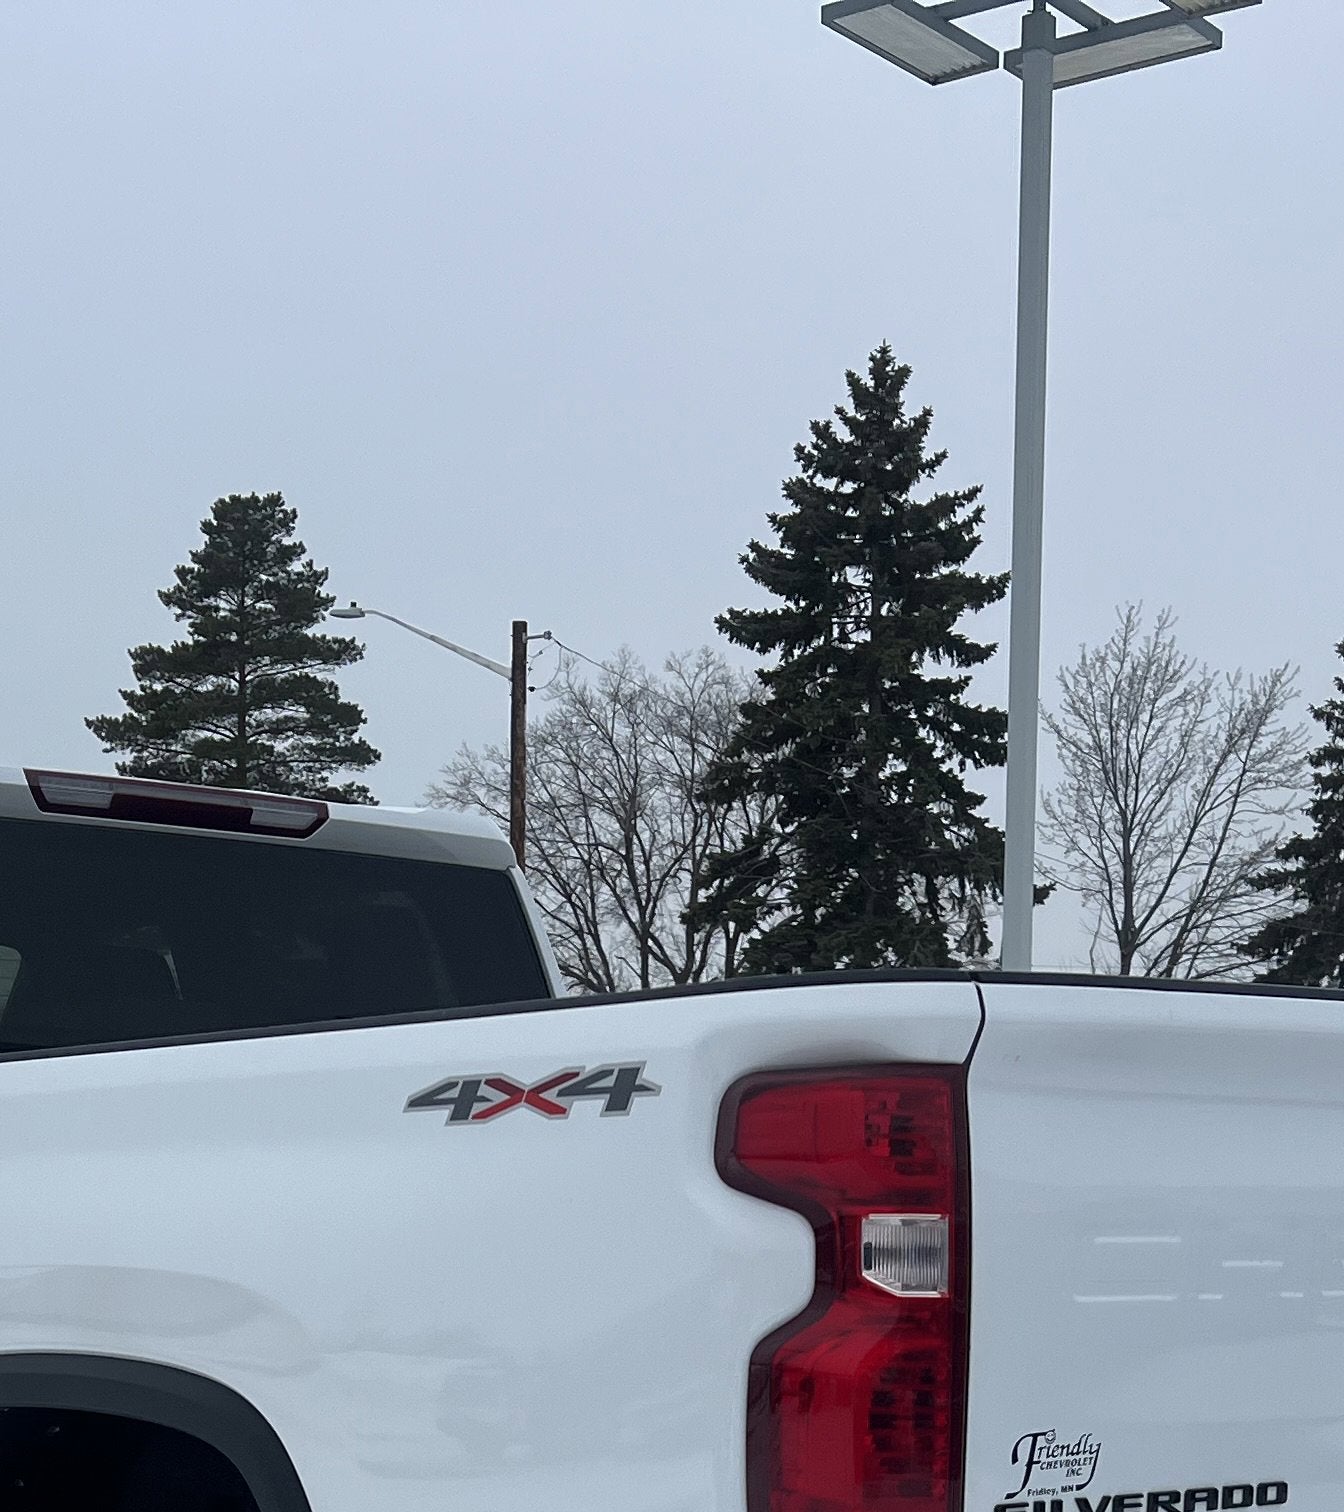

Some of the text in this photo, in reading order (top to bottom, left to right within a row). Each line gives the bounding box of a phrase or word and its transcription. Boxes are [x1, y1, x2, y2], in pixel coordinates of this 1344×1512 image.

[1004, 1428, 1102, 1500] Friendly
[1039, 1456, 1094, 1471] CHEVROLET
[1060, 1484, 1075, 1494] MN
